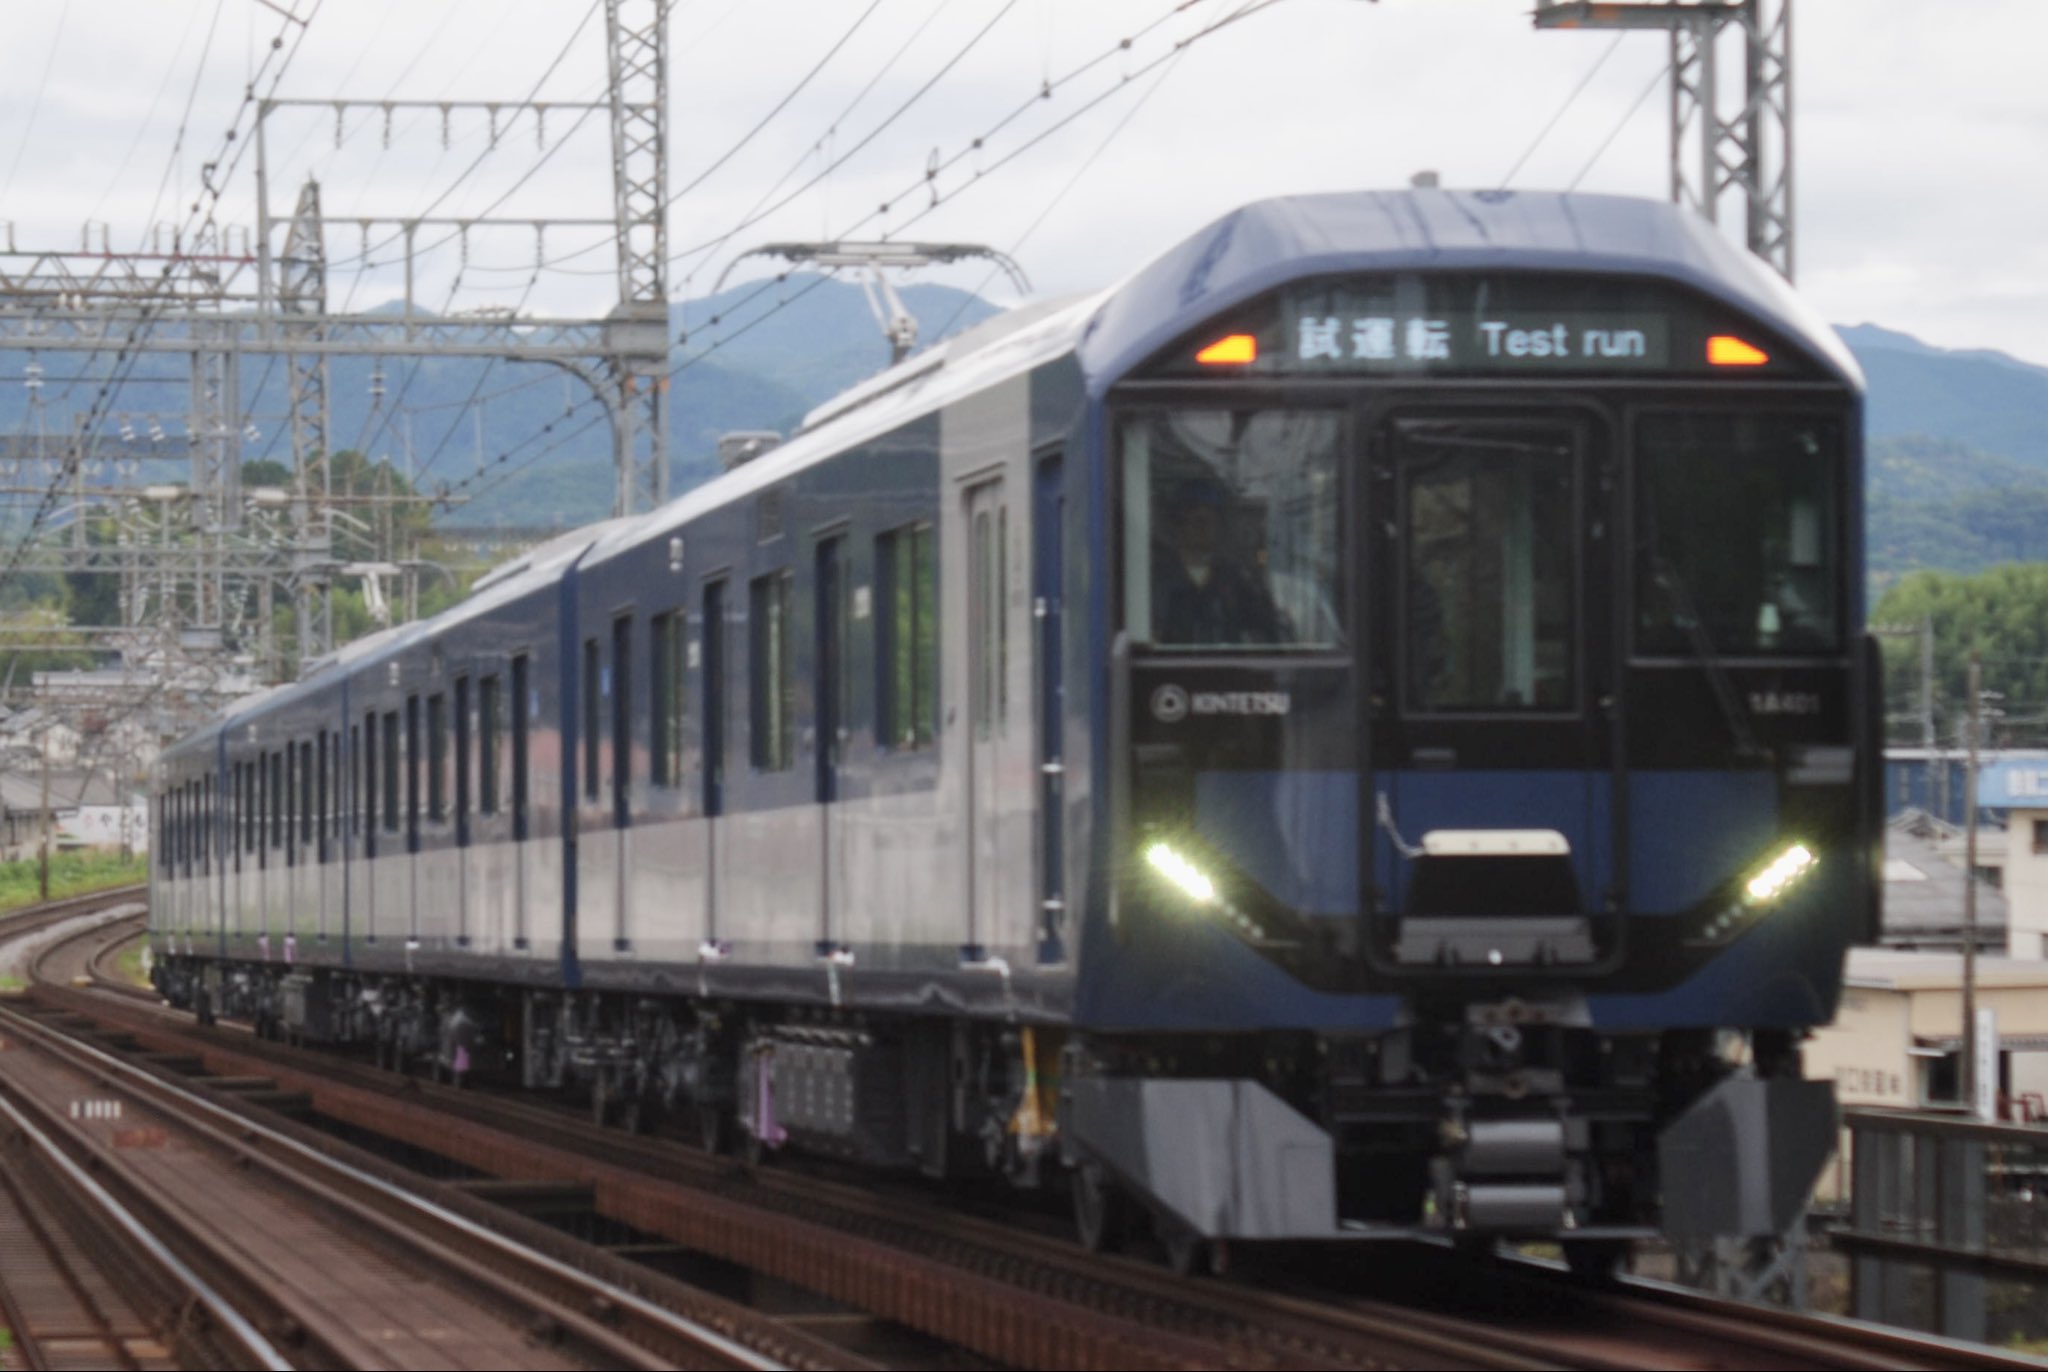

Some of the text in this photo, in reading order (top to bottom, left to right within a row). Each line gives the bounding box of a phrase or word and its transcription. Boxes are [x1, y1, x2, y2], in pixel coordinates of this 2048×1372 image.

[1299, 317, 1450, 359] 試運転
[1481, 321, 1645, 356] Test run
[1192, 692, 1290, 714] KINTETSU
